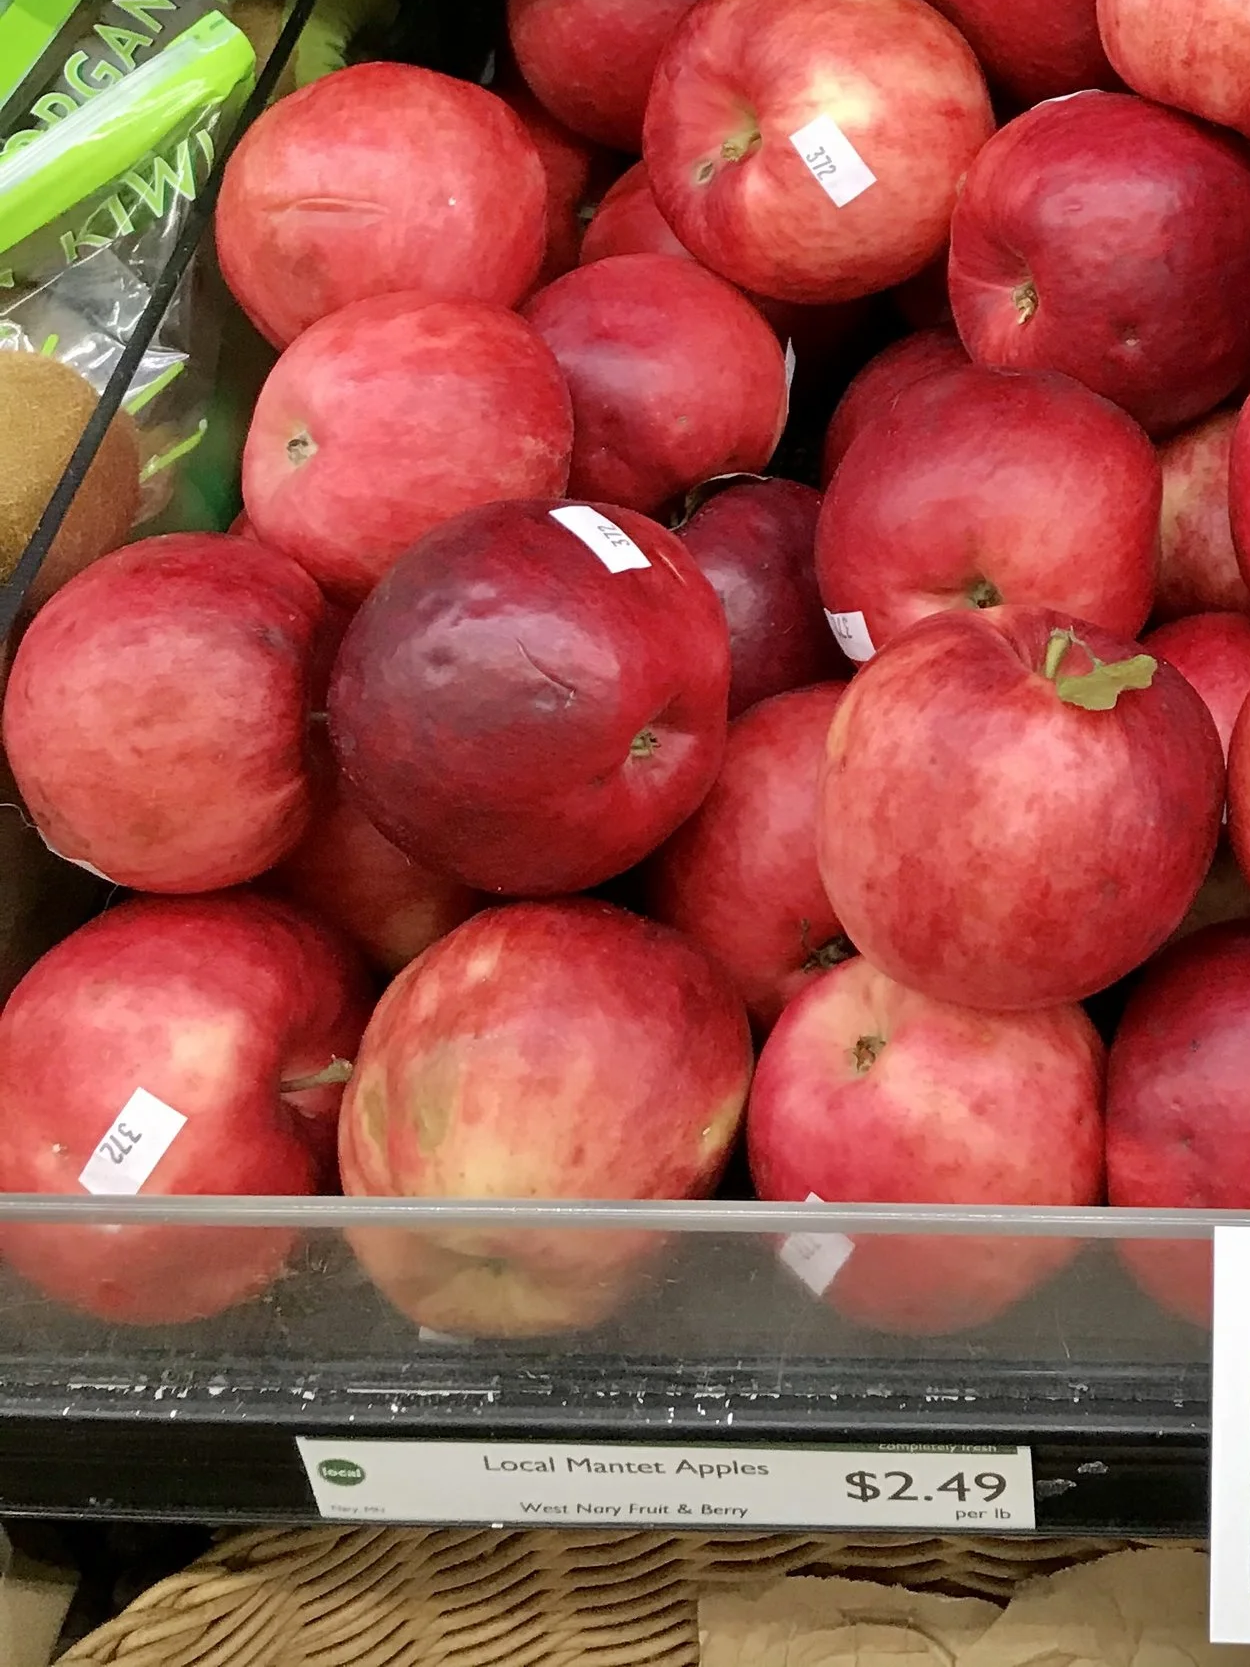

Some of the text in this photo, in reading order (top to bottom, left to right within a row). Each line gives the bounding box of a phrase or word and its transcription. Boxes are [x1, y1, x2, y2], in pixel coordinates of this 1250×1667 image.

[806, 146, 836, 181] 372
[597, 524, 630, 547] 372
[99, 1122, 142, 1165] 372
[322, 1466, 361, 1478] local
[483, 1455, 769, 1479] Local Mantet Apples
[845, 1470, 1007, 1502] $2.49
[520, 1502, 568, 1514] West
[629, 1502, 669, 1515] Fruit
[677, 1503, 692, 1515] &
[701, 1503, 748, 1518] Berry
[956, 1508, 1011, 1521] per lb
